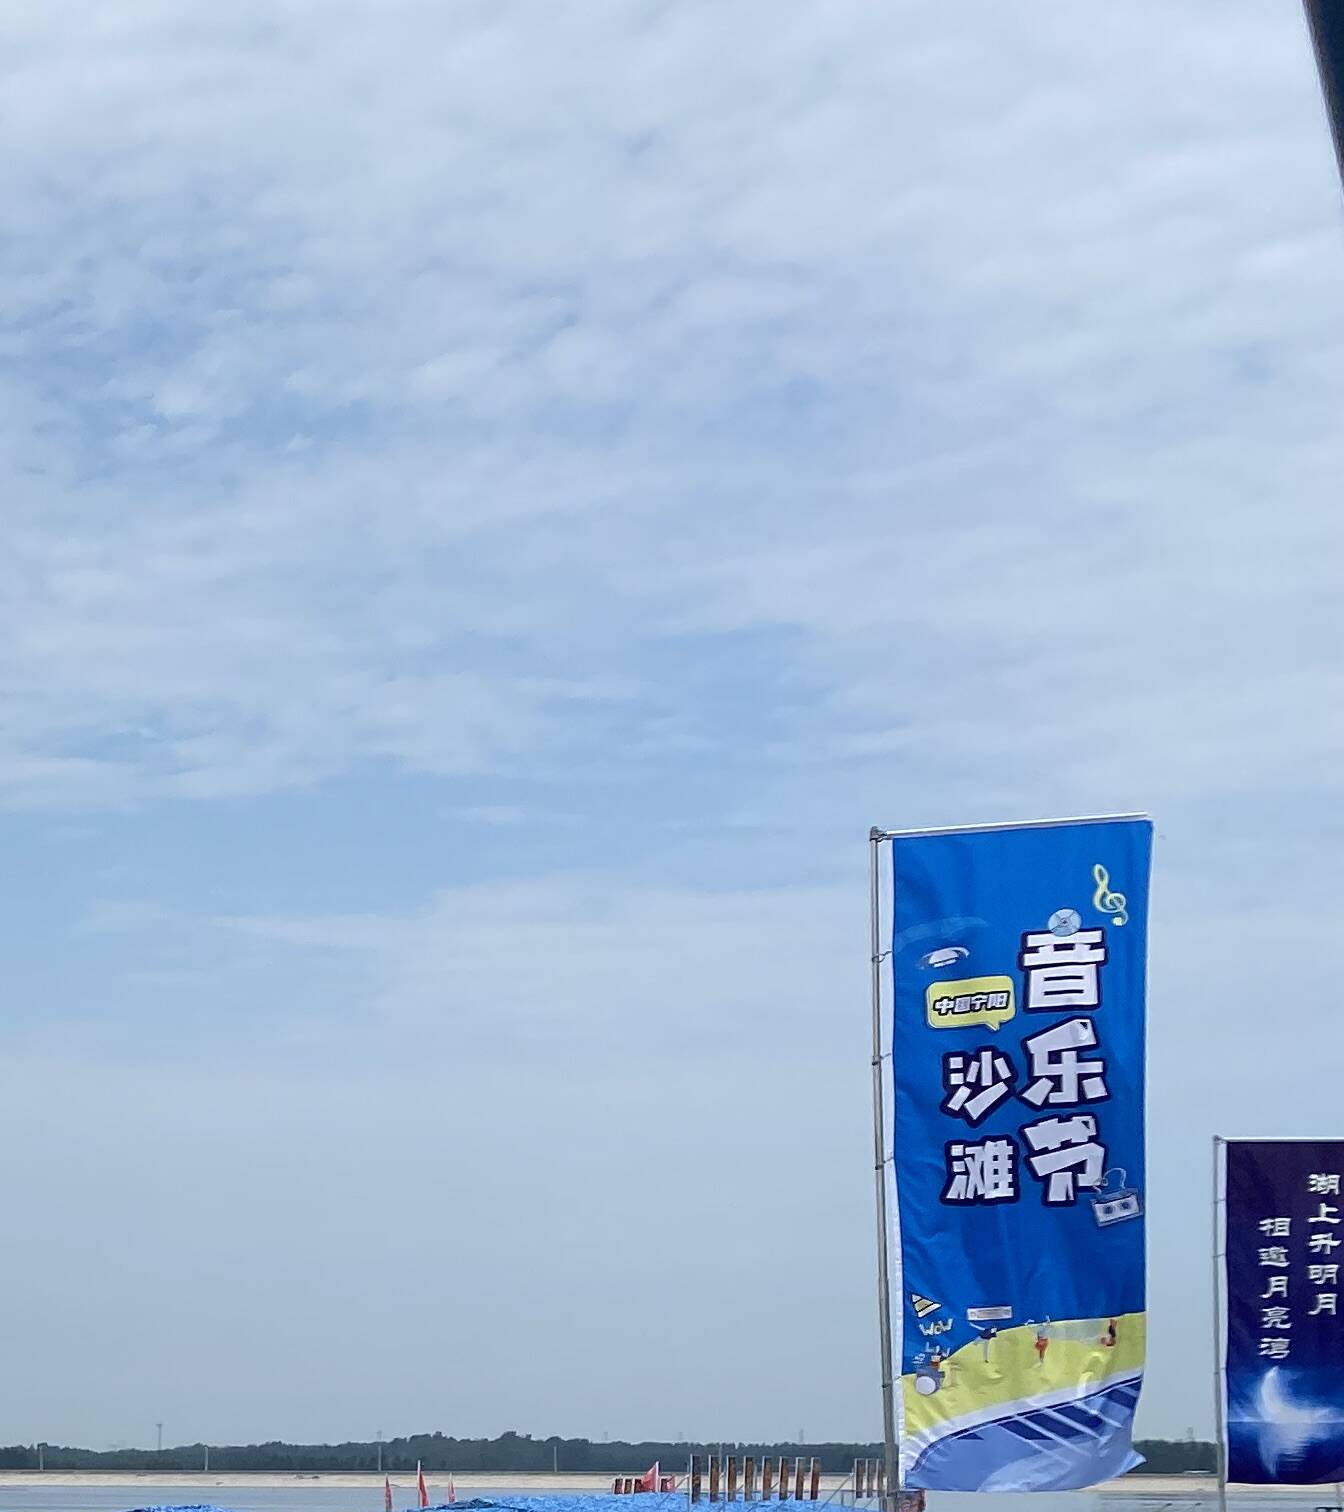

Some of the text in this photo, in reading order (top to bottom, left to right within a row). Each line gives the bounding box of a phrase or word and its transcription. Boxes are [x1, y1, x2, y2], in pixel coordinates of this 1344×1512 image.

[947, 1050, 1015, 1201] 沙滩
[1022, 929, 1107, 1202] 音乐节
[1307, 1173, 1342, 1316] 湖上升明月
